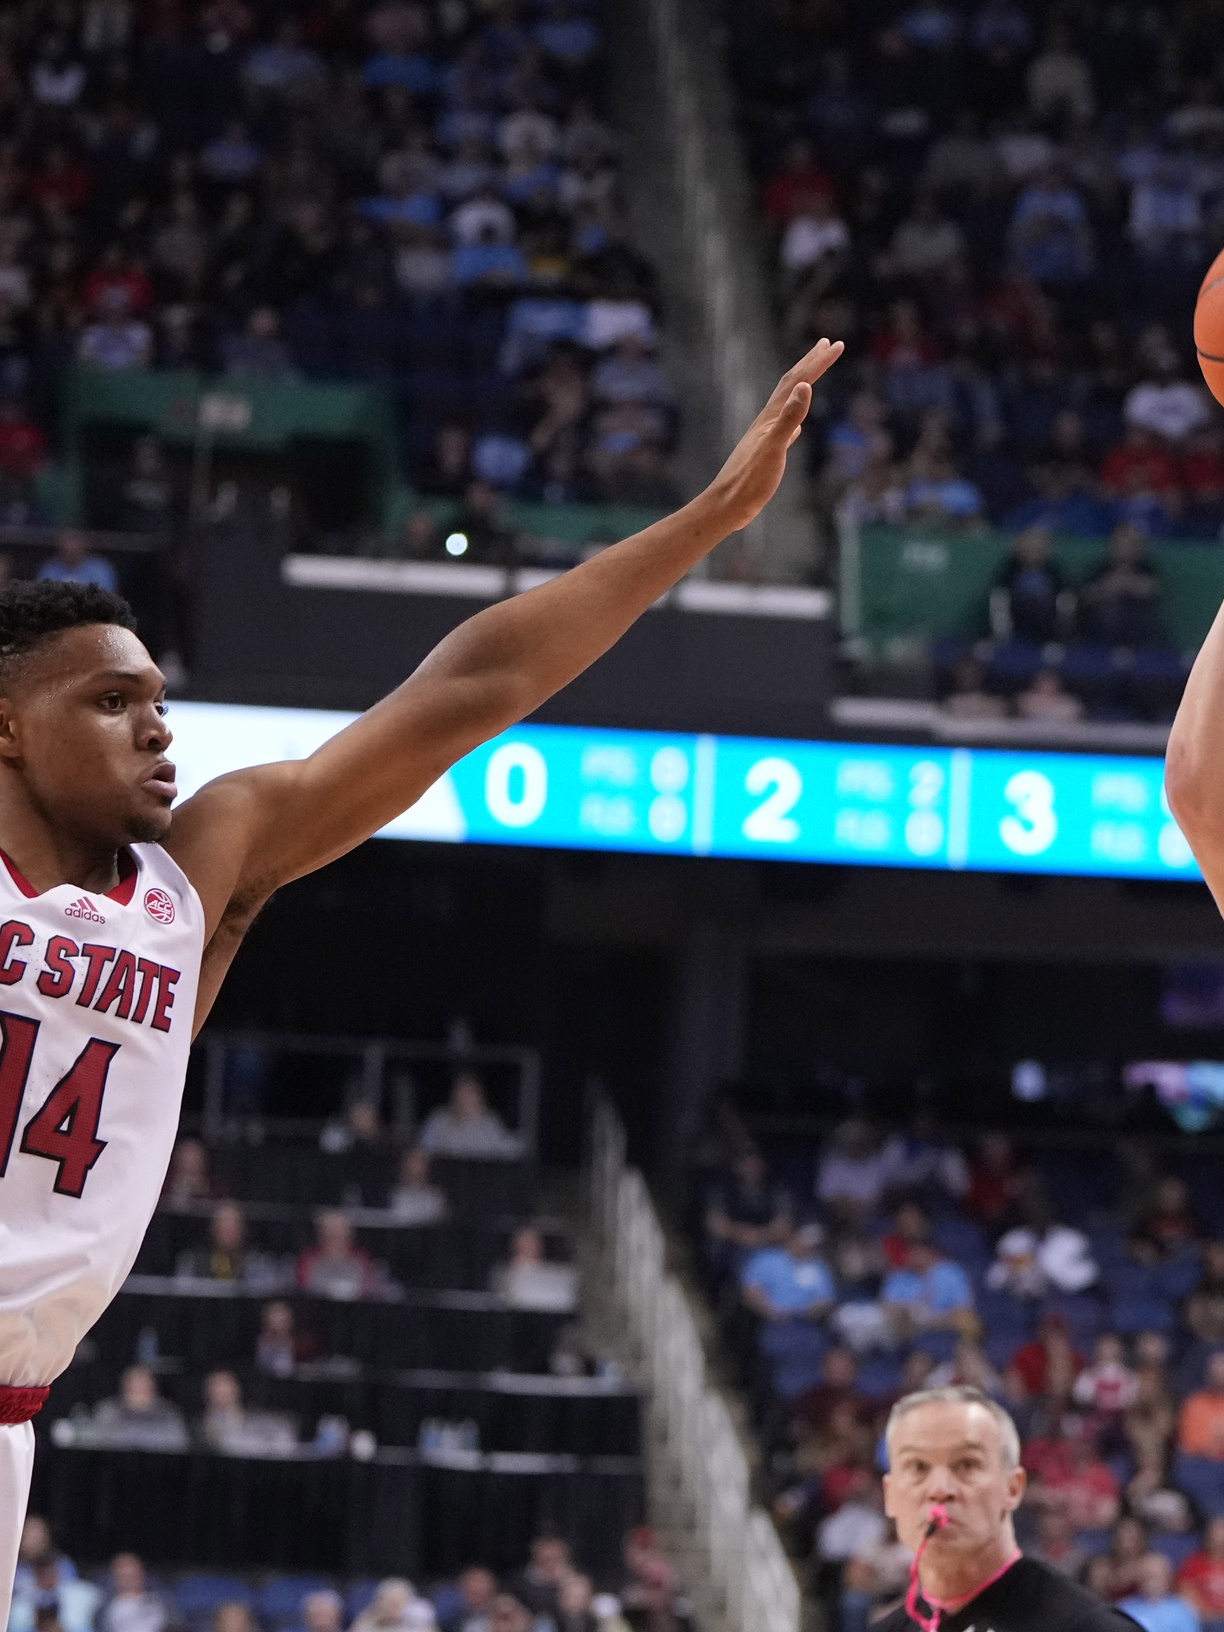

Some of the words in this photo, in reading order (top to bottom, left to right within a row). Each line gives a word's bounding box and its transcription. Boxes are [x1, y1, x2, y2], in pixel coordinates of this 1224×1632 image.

[485, 742, 547, 827] 0
[744, 758, 802, 842] 2
[1000, 770, 1058, 855] 3
[64, 906, 106, 925] adidas
[147, 899, 173, 914] ACC
[36, 934, 181, 1033] STATE
[0, 1009, 122, 1199] 14
